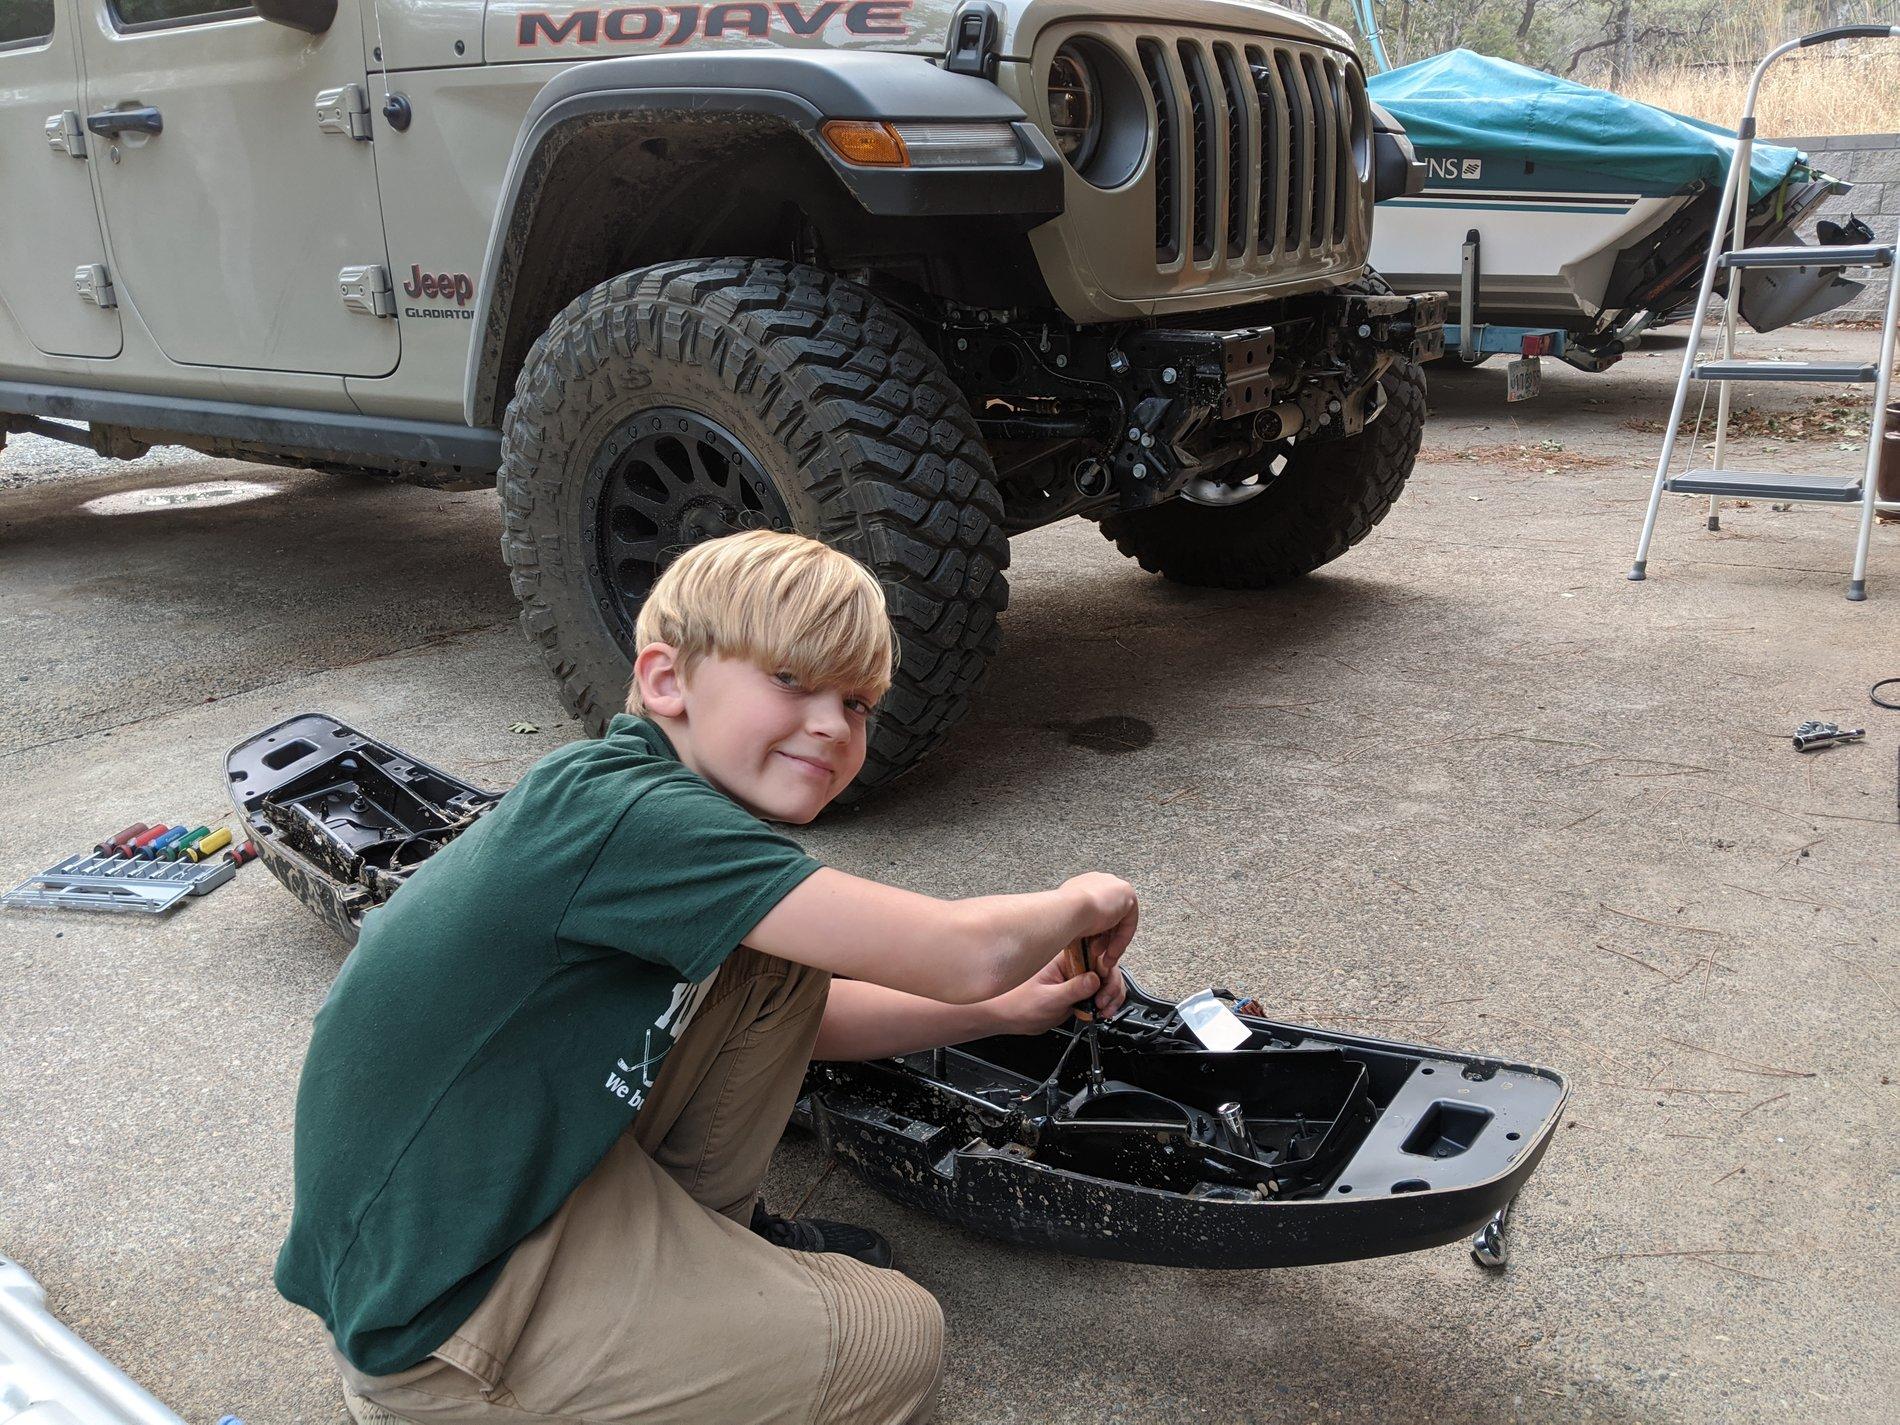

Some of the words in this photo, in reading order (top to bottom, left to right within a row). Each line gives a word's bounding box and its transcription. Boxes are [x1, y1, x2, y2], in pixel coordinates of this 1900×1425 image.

[517, 0, 913, 48] MOJAVE
[1424, 157, 1458, 179] NS
[403, 264, 474, 306] Jeep
[605, 1072, 629, 1098] We
